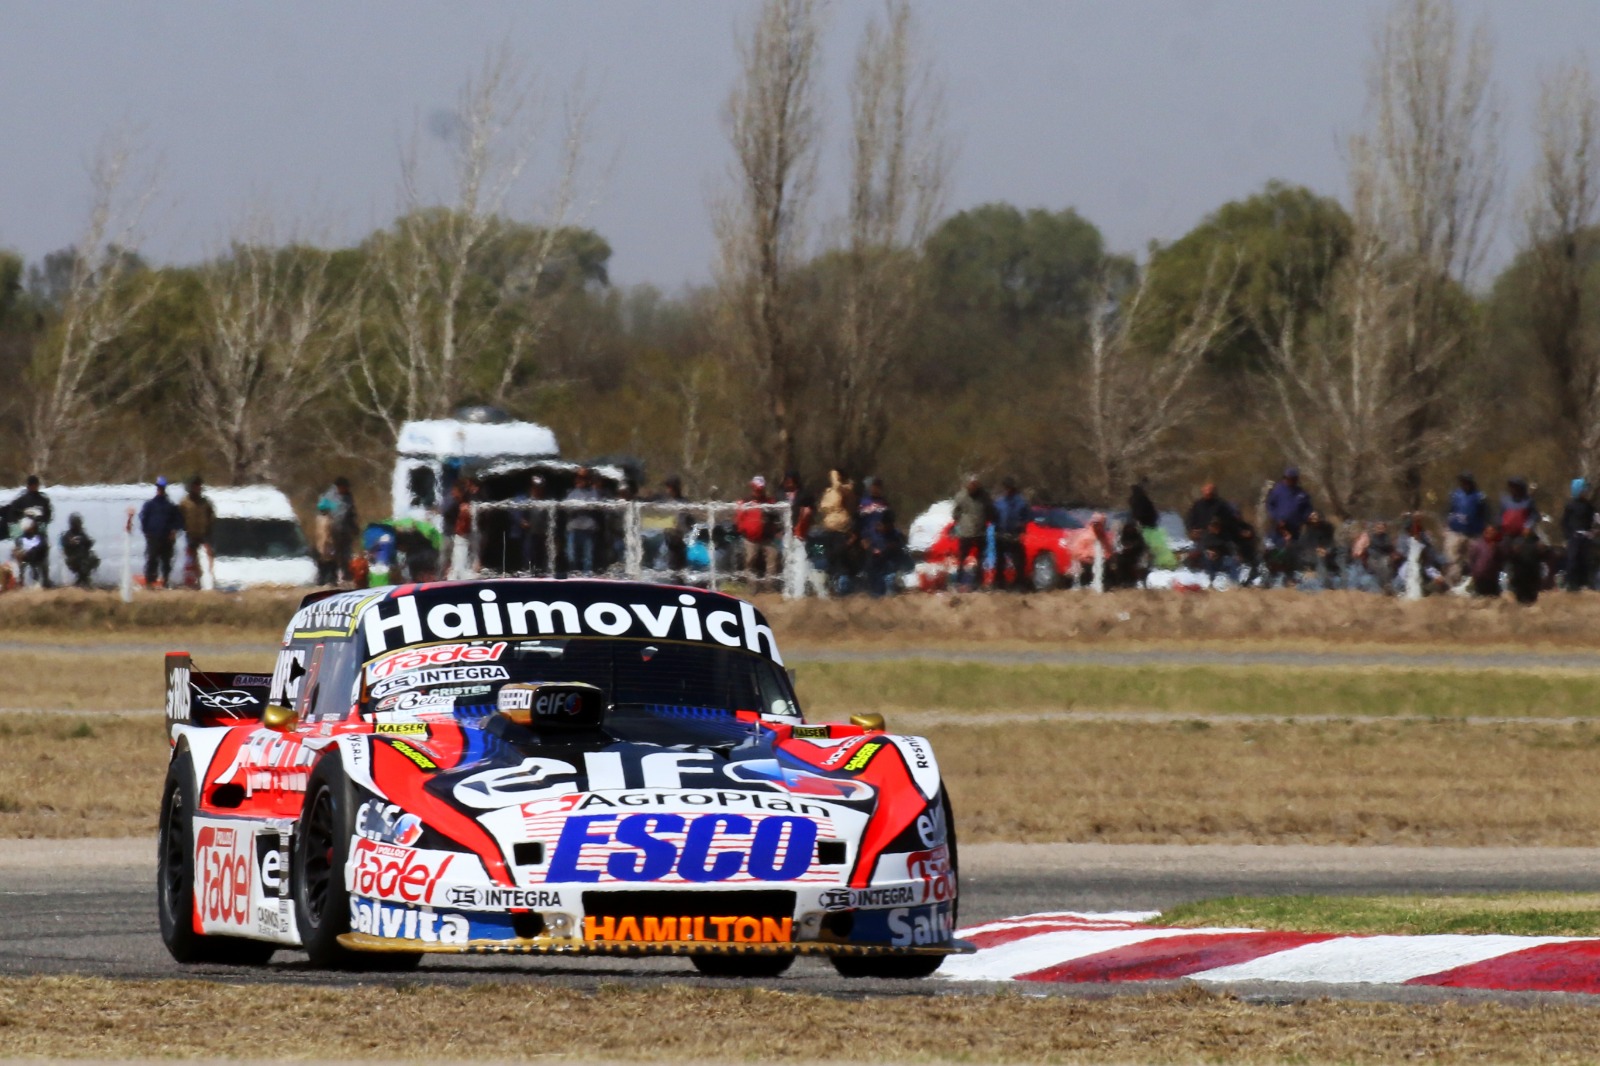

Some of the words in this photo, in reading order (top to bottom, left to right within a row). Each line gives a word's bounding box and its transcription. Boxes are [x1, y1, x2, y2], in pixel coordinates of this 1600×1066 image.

[364, 588, 784, 666] Haimovich
[374, 643, 504, 677] Fadel
[421, 667, 506, 683] INTEGRA
[536, 692, 566, 715] elf
[378, 723, 424, 733] KAESER
[377, 846, 406, 857] POLLOS
[544, 813, 818, 883] ESCO
[196, 826, 254, 925] Fadel
[353, 838, 455, 904] Fadel
[485, 890, 563, 906] INTEGRA
[858, 887, 914, 906] INTEGRA
[350, 895, 470, 945] Salvita
[584, 916, 793, 942] HAMILTON
